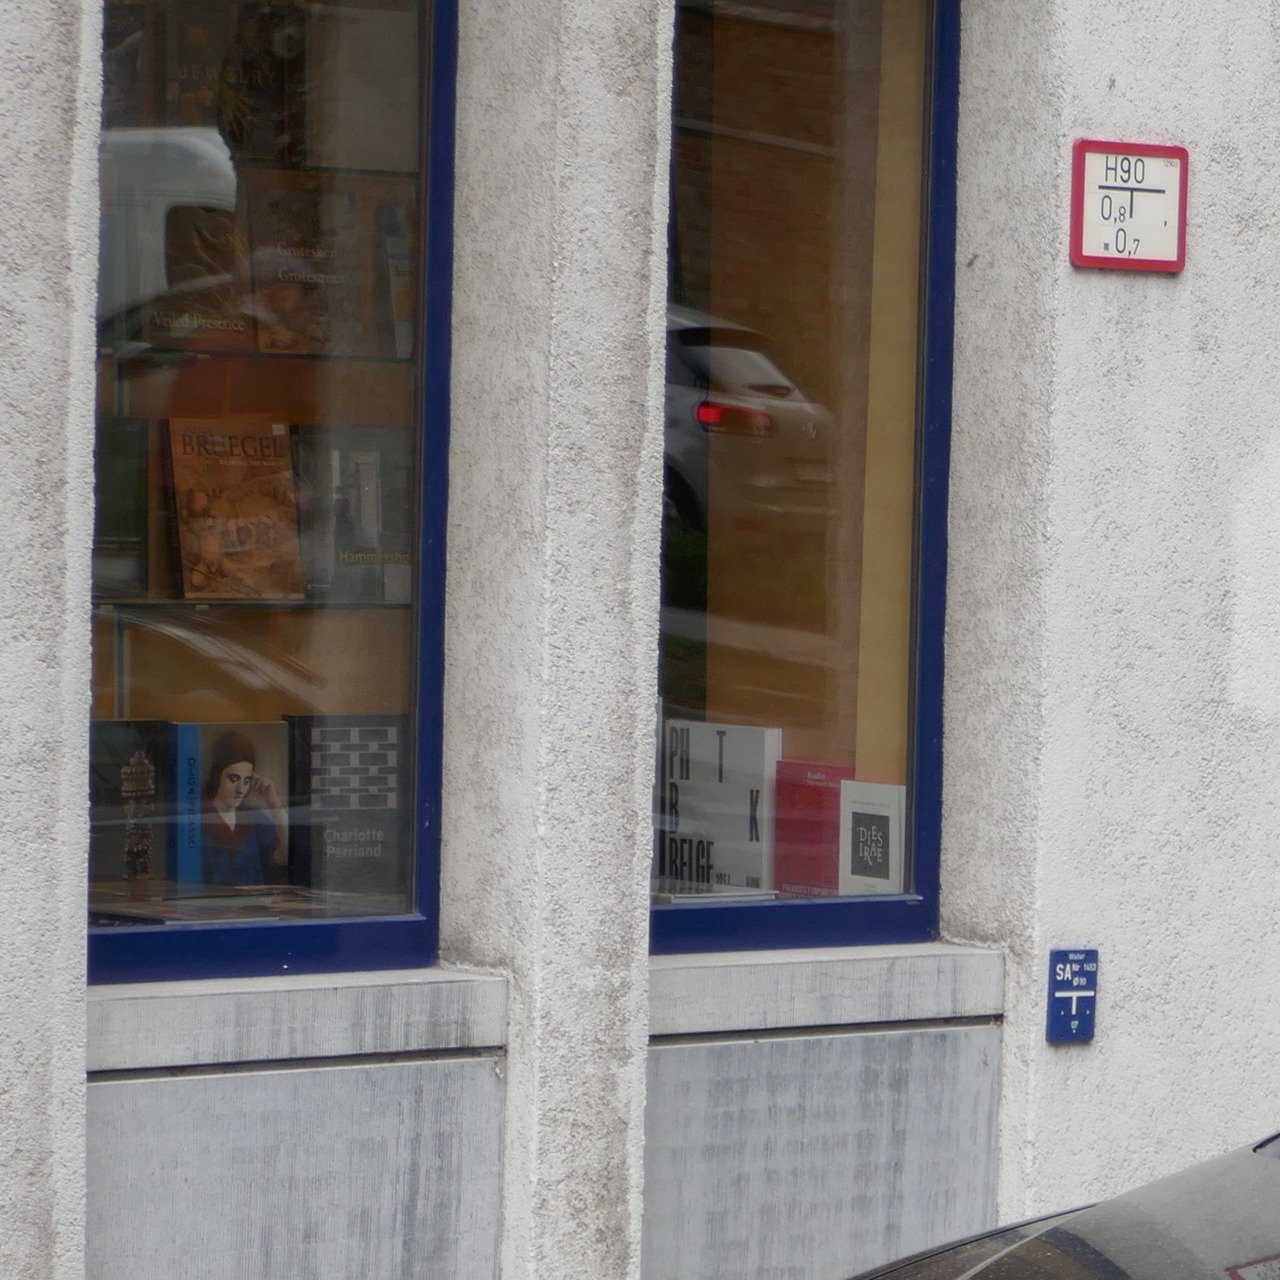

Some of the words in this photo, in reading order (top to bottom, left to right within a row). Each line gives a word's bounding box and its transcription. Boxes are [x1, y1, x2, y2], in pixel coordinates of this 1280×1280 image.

[1104, 155, 1145, 184] H90
[1100, 195, 1127, 224] 0,8
[1115, 228, 1141, 257] 0,7
[193, 313, 247, 331] Presence
[181, 434, 285, 458] BRUEGEL
[324, 829, 384, 843] Charlotte
[857, 825, 883, 847] DIES
[326, 843, 382, 858] Perriand
[859, 842, 883, 866] IRAE
[1055, 963, 1072, 981] SA
